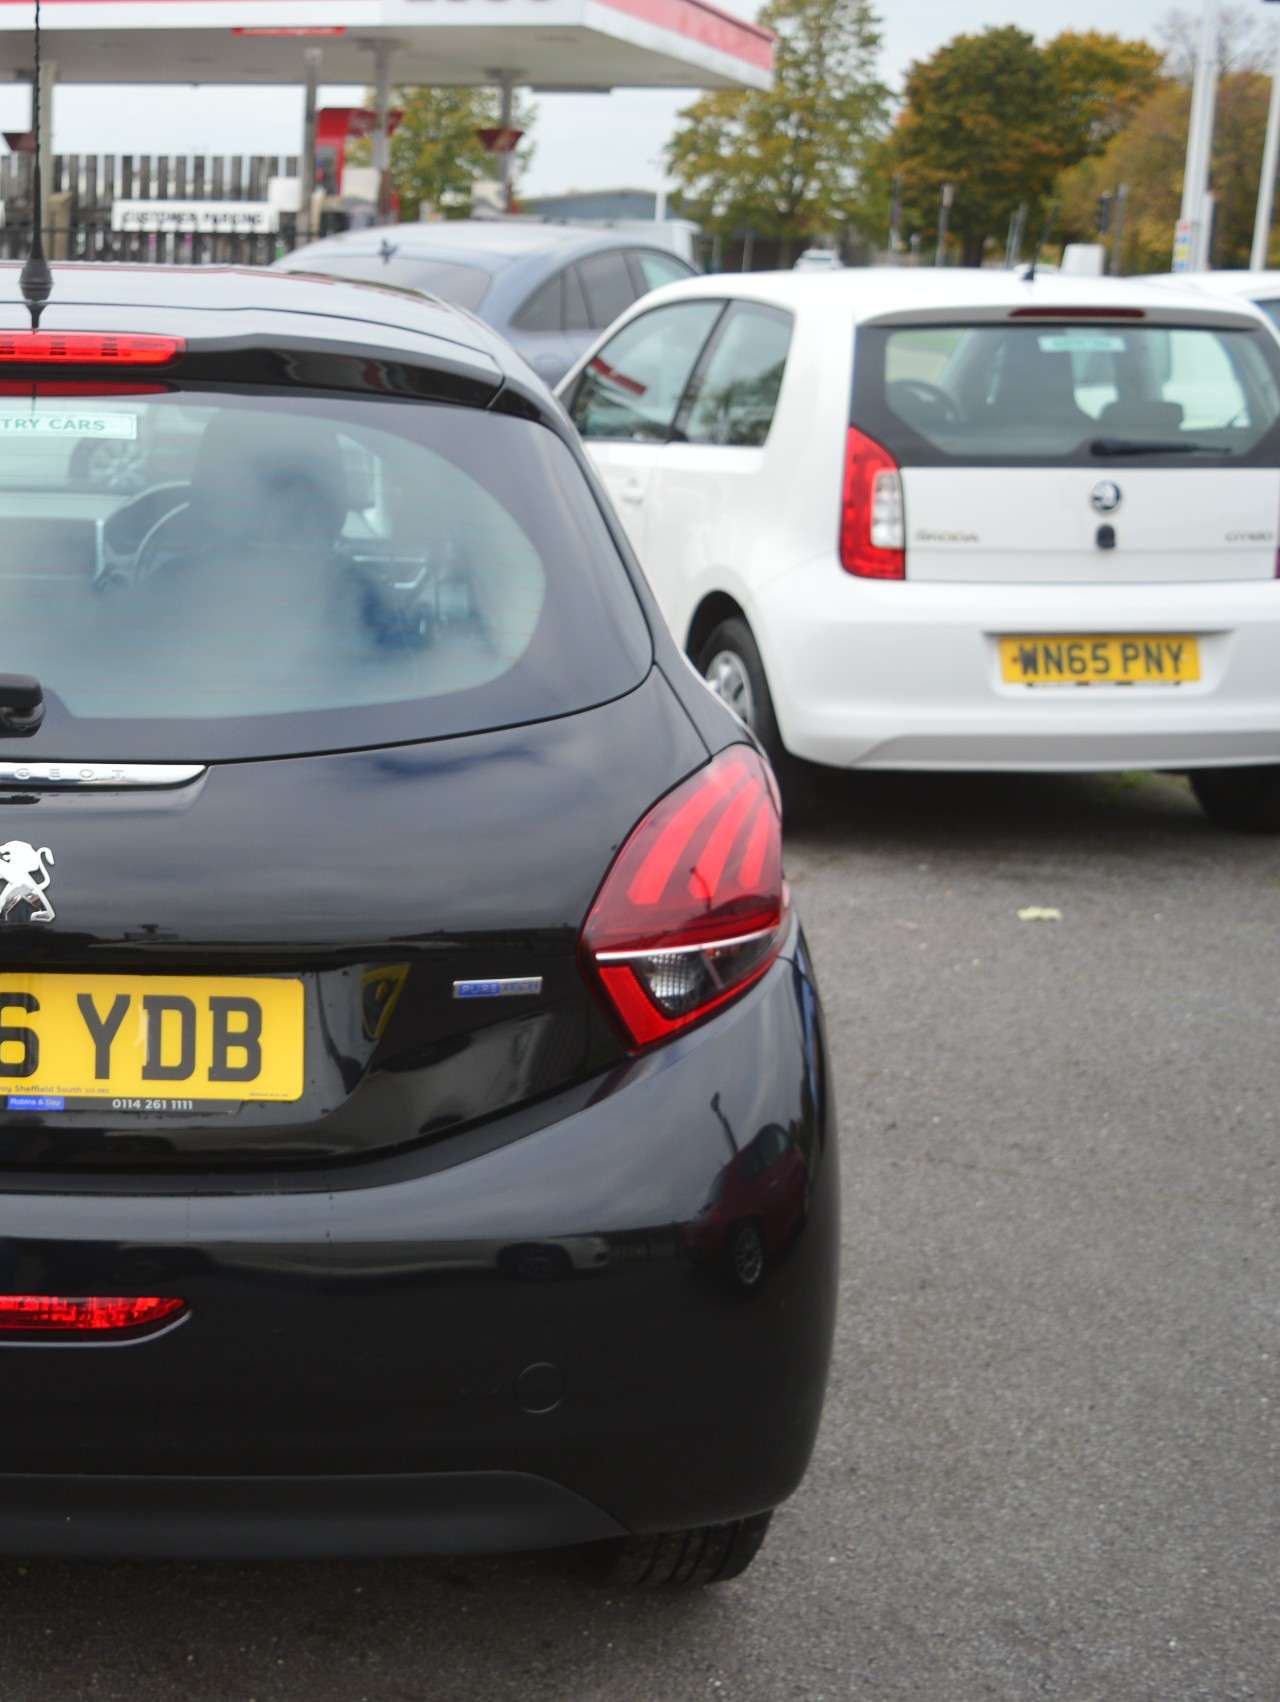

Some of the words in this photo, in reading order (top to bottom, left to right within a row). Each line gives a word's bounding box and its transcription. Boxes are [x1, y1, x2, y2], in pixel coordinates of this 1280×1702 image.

[122, 211, 198, 224] CUSTOMER
[204, 212, 263, 224] PARKING
[49, 419, 106, 431] CARS
[1020, 642, 1111, 676] WN65
[1122, 641, 1184, 675] PNY
[76, 993, 263, 1083] YDB
[15, 1084, 55, 1093] Sheffield
[112, 1098, 142, 1109] 0114
[144, 1099, 168, 1110] 261
[171, 1100, 194, 1110] 1111
